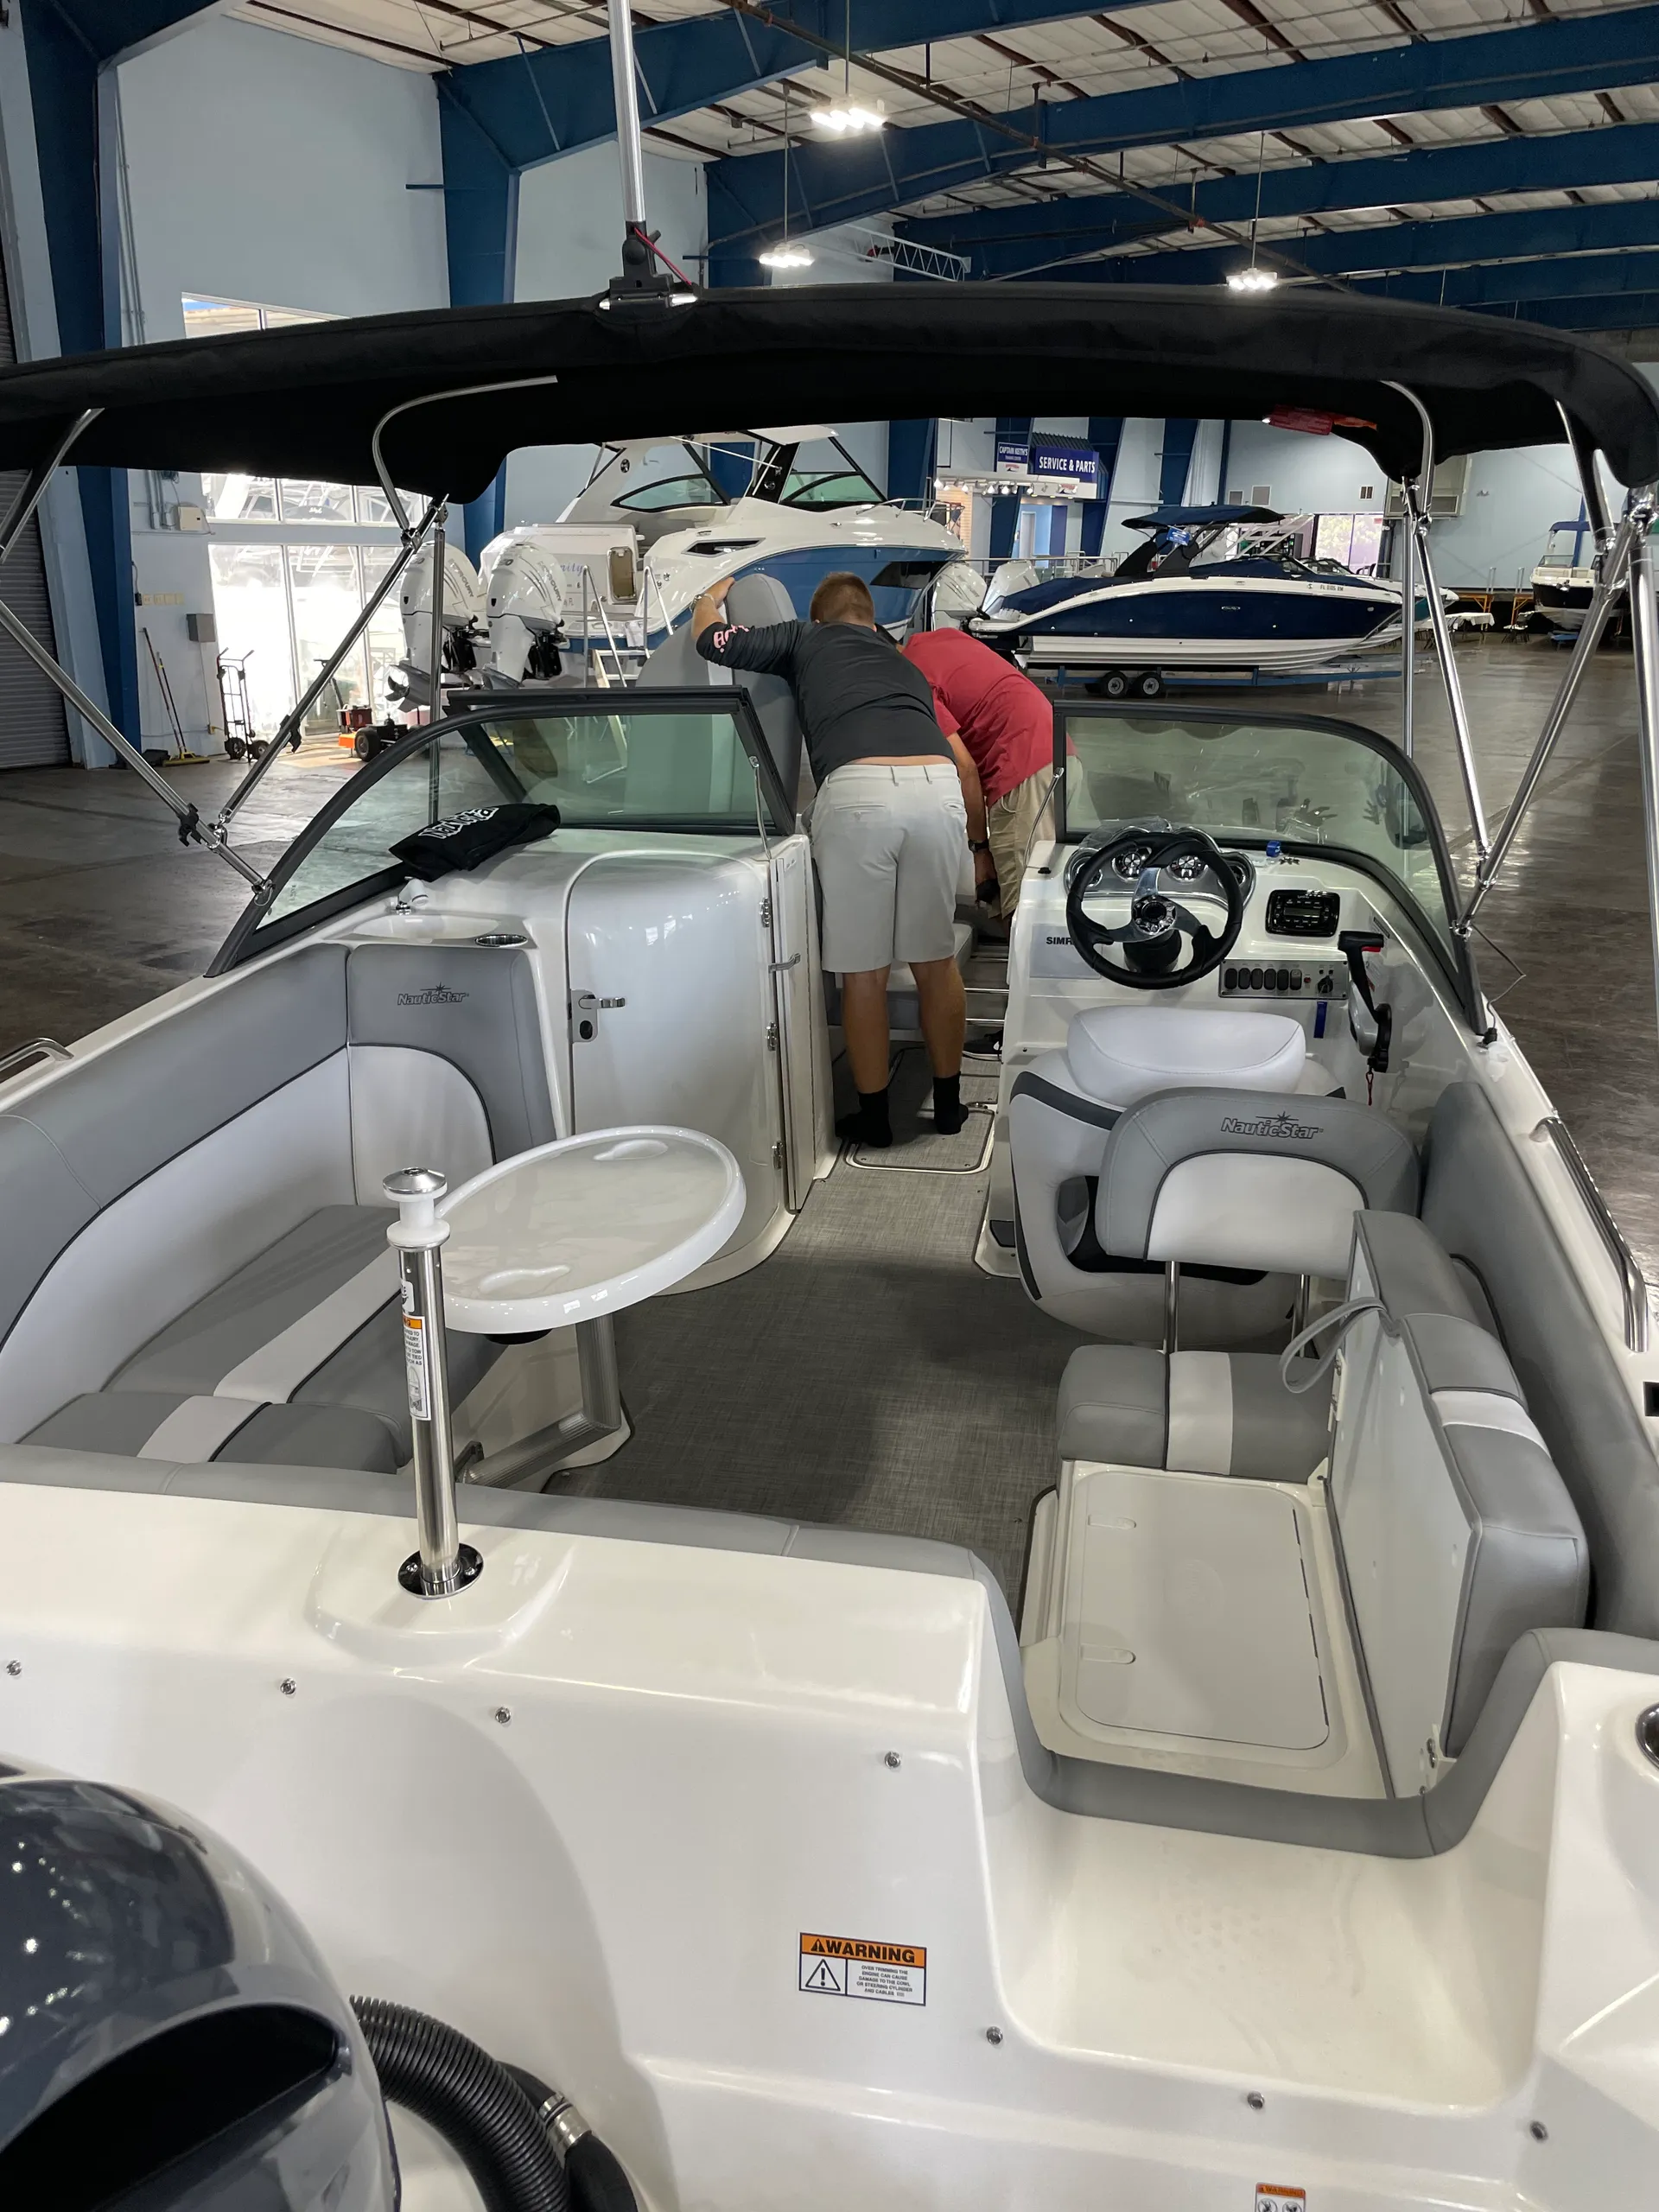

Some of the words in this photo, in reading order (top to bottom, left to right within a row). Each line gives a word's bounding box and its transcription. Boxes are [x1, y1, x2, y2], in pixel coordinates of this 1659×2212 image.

[1039, 455, 1067, 471] SERVICE
[1069, 459, 1074, 471] &
[1075, 460, 1096, 474] PARTS
[1046, 936, 1071, 945] SIMR
[397, 990, 467, 1005] NauticStar
[1221, 1116, 1319, 1140] NauticStar
[825, 1939, 915, 1964] WARNING
